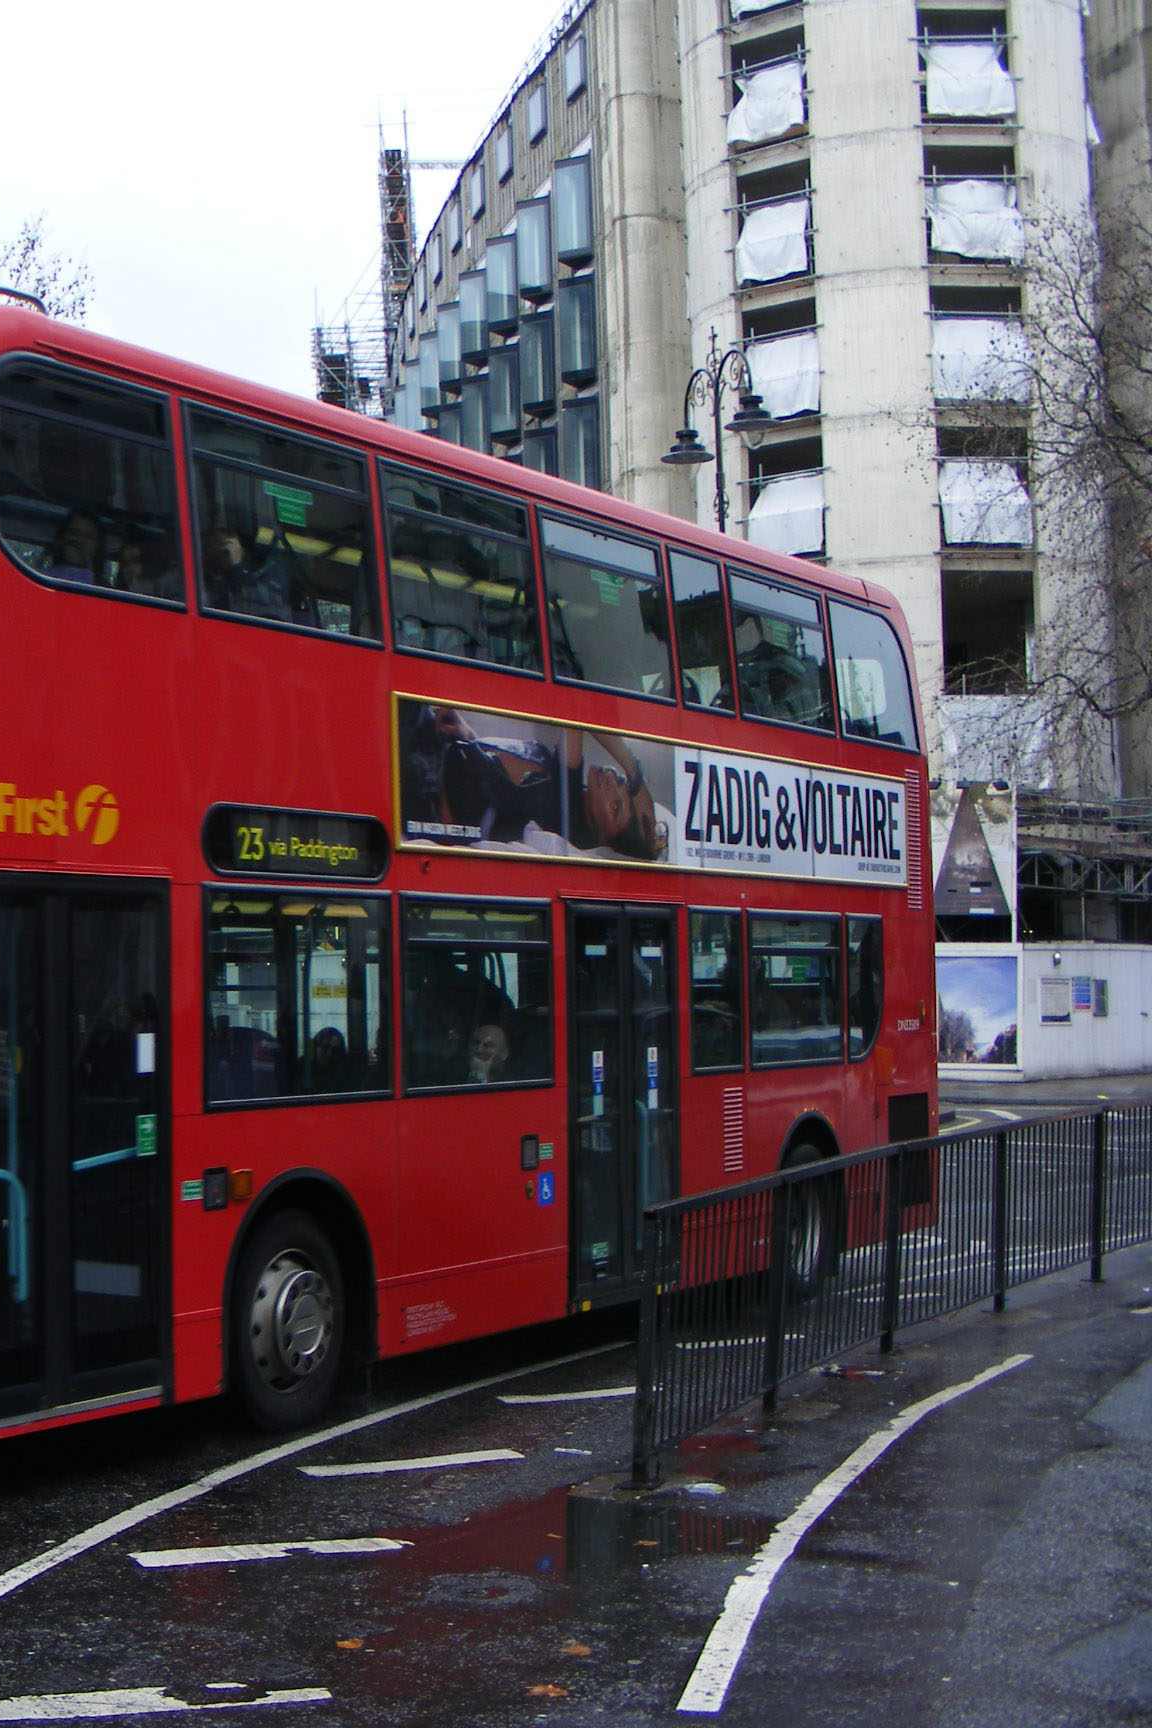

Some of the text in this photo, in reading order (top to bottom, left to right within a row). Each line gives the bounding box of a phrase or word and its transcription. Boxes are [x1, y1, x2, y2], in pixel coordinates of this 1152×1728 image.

[237, 826, 359, 866] 23 via Paddington
